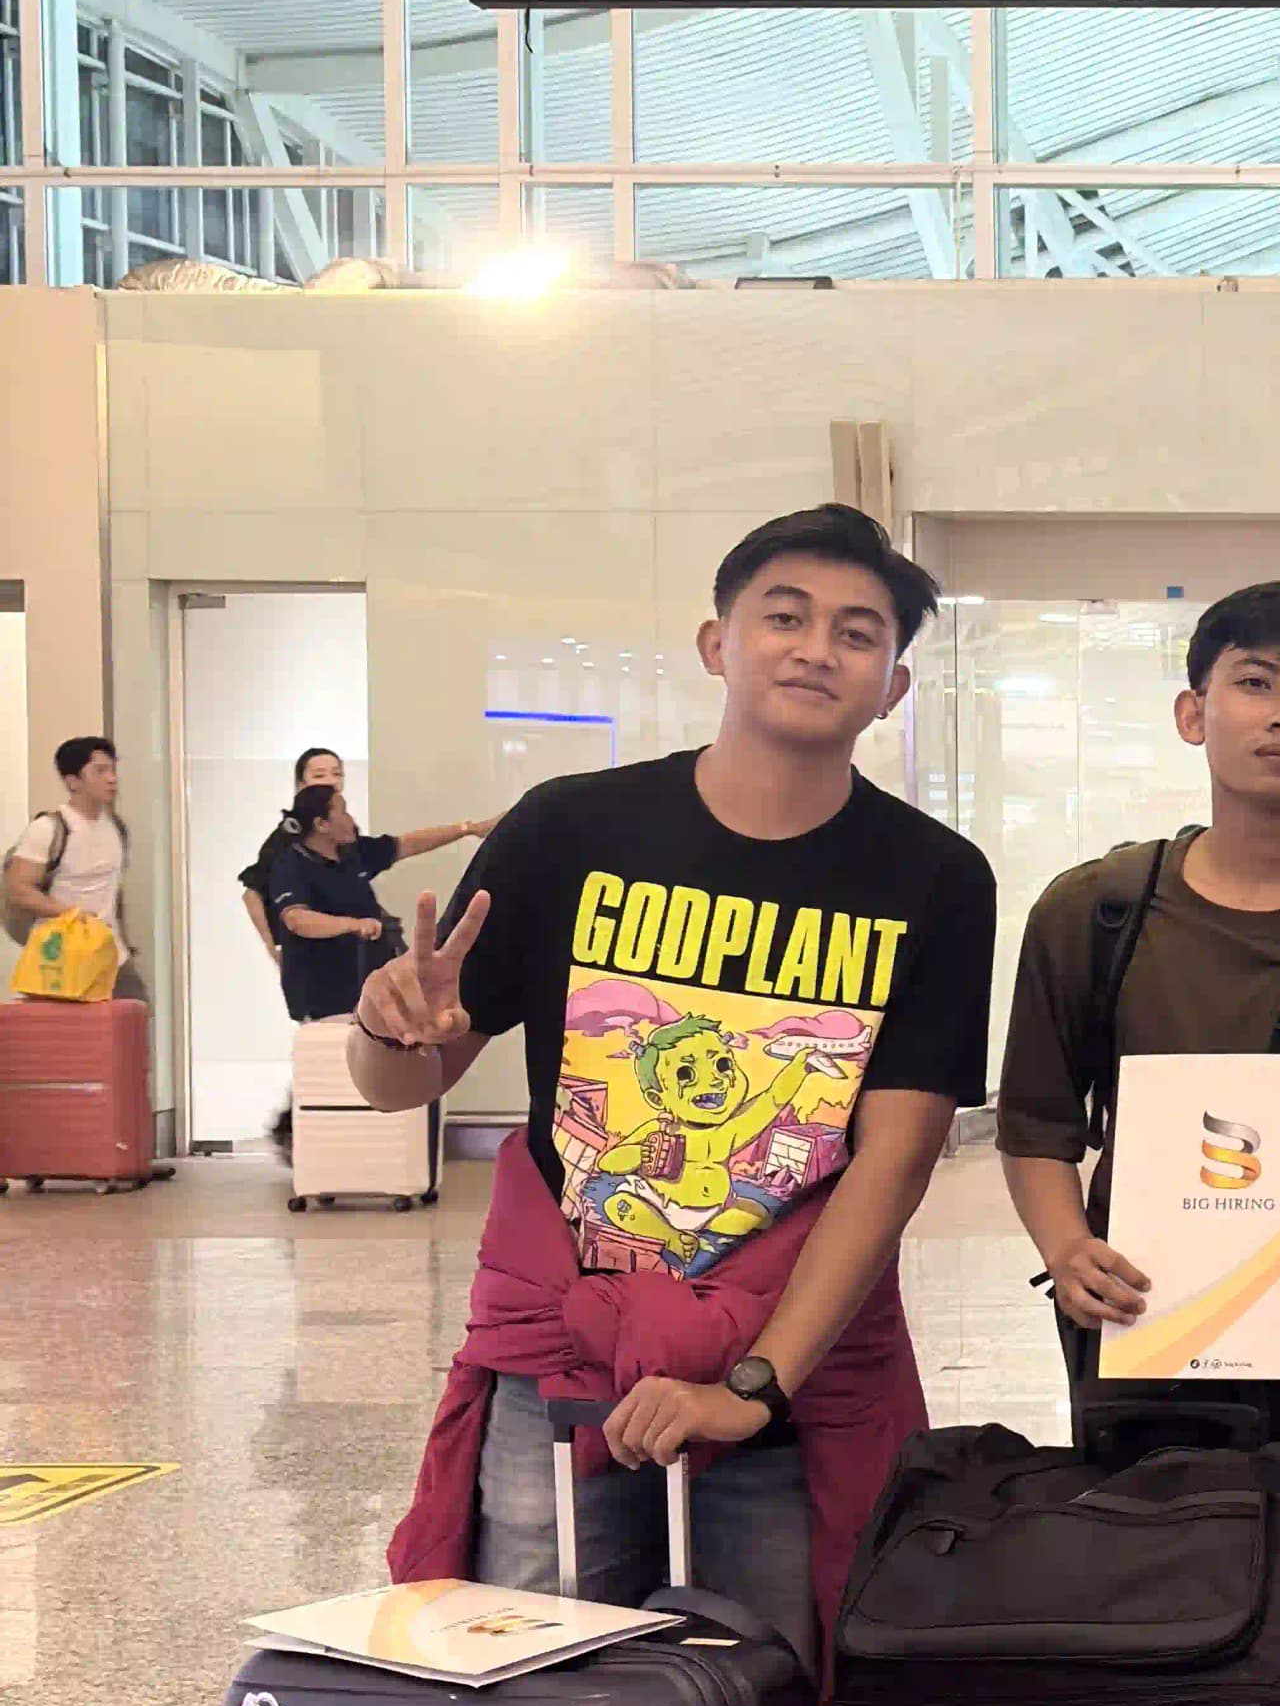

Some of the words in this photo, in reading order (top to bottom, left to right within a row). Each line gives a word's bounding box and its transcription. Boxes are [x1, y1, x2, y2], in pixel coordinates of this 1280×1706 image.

[573, 869, 909, 1008] GODPLANT
[1182, 1197, 1210, 1211] BIG
[1215, 1197, 1276, 1211] HIRING
